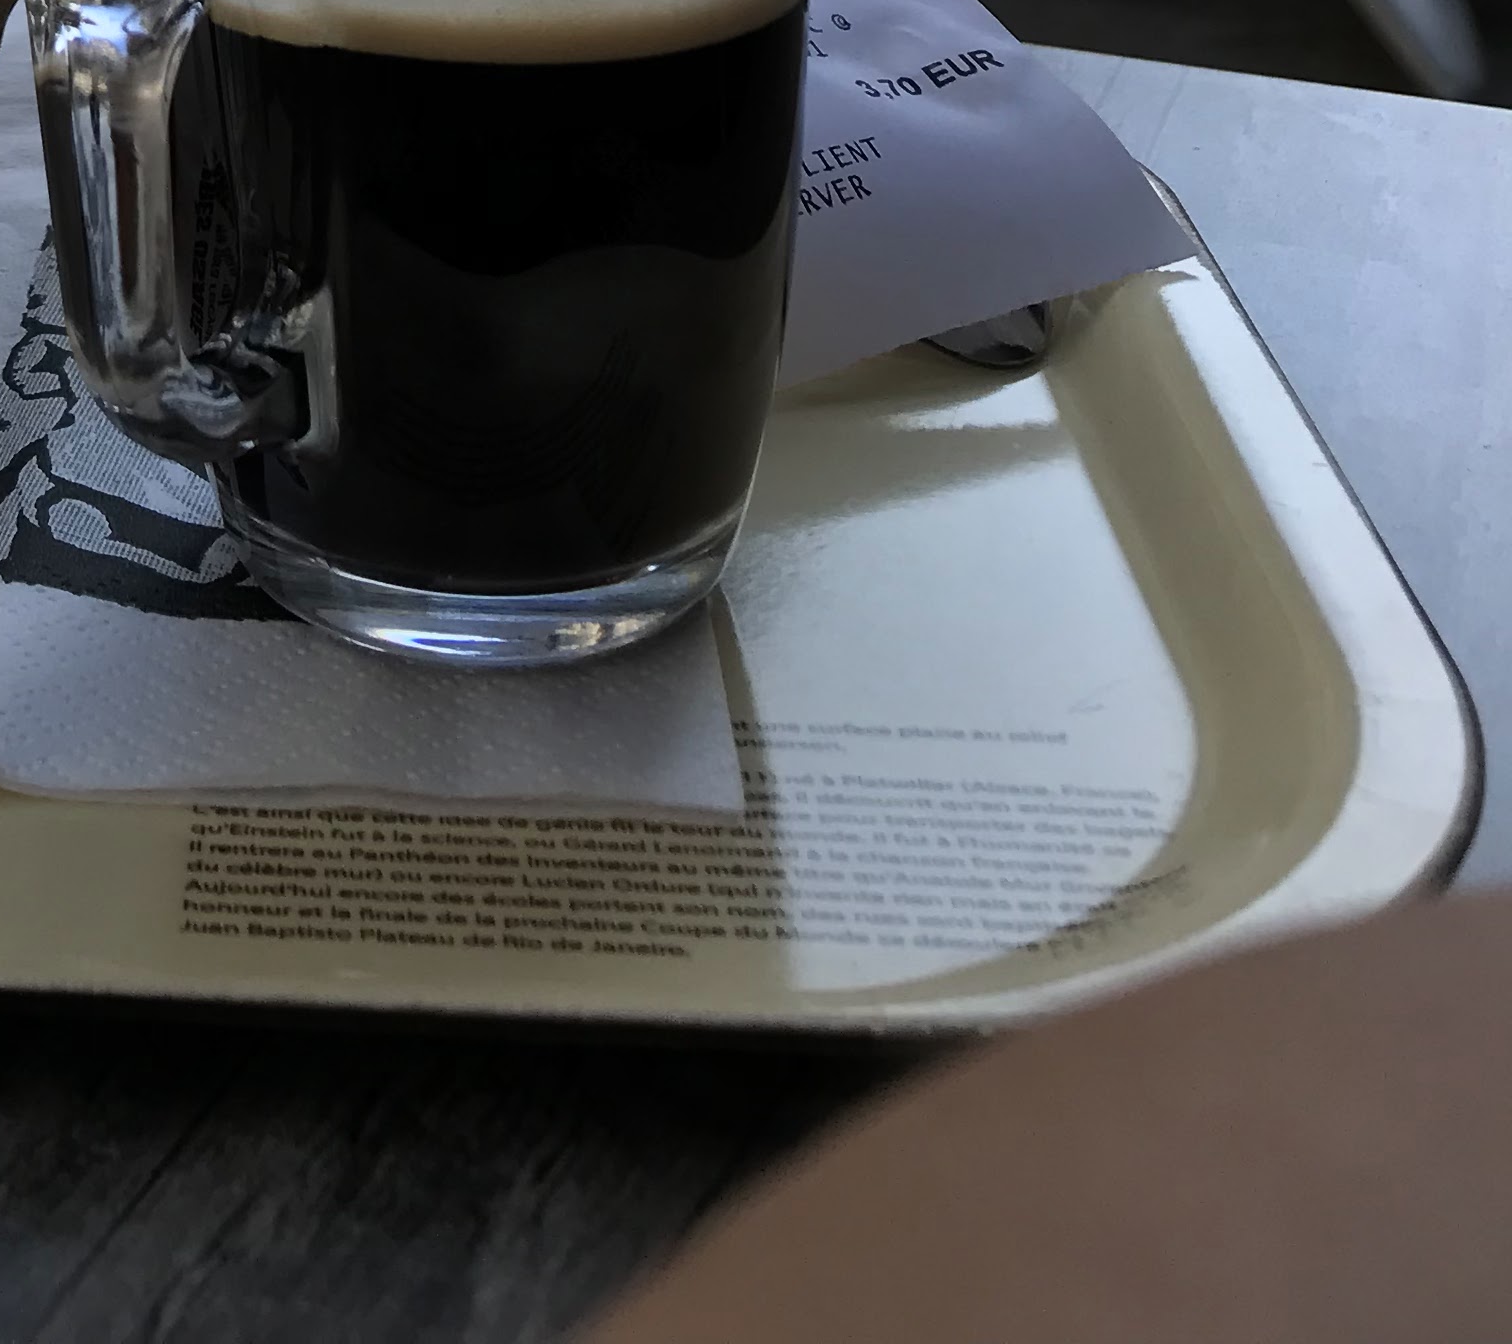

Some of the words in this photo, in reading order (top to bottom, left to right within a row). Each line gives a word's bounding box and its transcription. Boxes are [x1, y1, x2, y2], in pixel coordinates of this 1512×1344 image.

[854, 75, 923, 100] 3,70
[921, 48, 1006, 90] EUR
[798, 173, 873, 217] RVER
[316, 809, 366, 824] que
[371, 811, 433, 824] cette
[497, 815, 529, 829] de
[728, 825, 763, 839] du
[189, 822, 325, 841] qu'Einstein
[330, 827, 366, 842] fut
[392, 829, 414, 844] la
[524, 837, 556, 850] ou
[856, 850, 966, 868] chanson
[209, 842, 306, 858] rentrera
[311, 847, 343, 861] au
[349, 847, 471, 865] Panthéon
[476, 851, 520, 867] des
[666, 862, 698, 876] au
[186, 858, 220, 874] du
[225, 860, 317, 878] célèbre
[389, 870, 423, 884] ou
[428, 872, 515, 888] encore
[521, 873, 606, 891] Lucien
[182, 898, 290, 918] honneur
[297, 906, 323, 920] et
[330, 904, 352, 921] la
[358, 907, 429, 923] finale
[436, 910, 468, 926] de
[474, 911, 496, 927] la
[503, 914, 635, 934] prochaine
[184, 878, 332, 899] Aujourd'hui
[337, 887, 425, 903] encore
[431, 890, 475, 905] des
[481, 892, 563, 911] écoles
[568, 898, 666, 916] portent
[672, 904, 719, 918] son
[181, 917, 241, 935] Juan
[359, 928, 456, 947] Plateau
[461, 931, 495, 949] de
[501, 933, 544, 951] Rio
[550, 936, 583, 952] de
